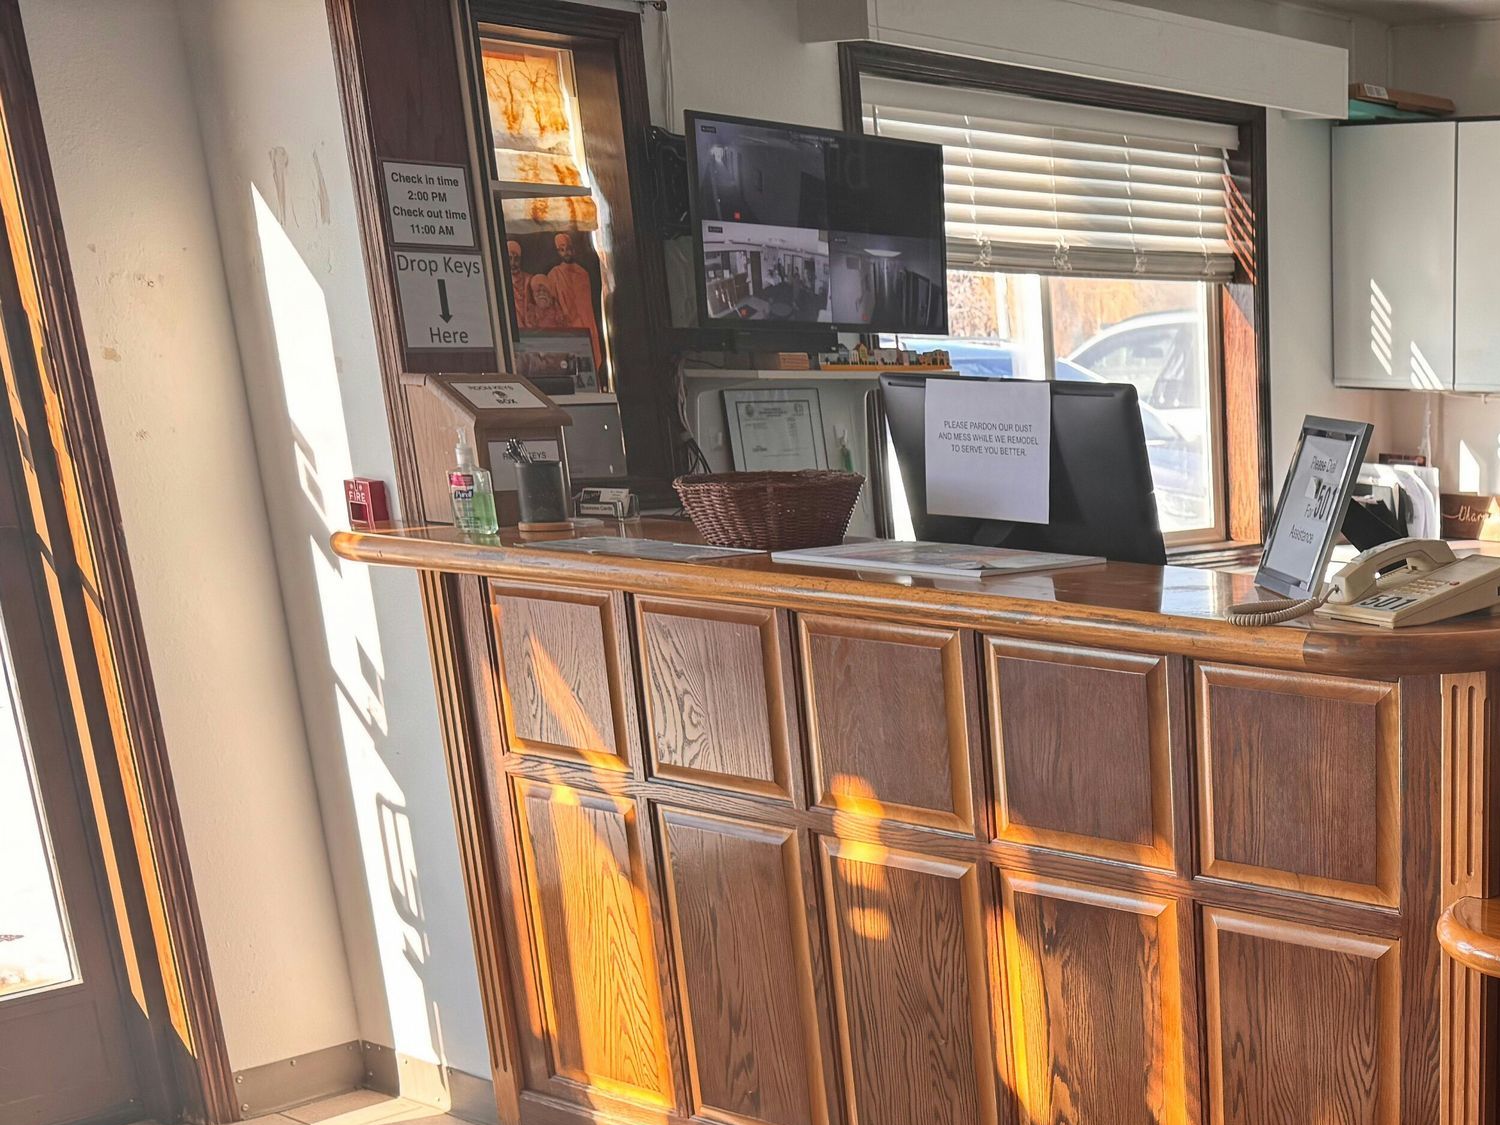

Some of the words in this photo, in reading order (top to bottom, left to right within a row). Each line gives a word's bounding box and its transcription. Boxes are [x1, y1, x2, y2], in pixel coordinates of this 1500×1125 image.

[391, 172, 423, 185] Check
[437, 176, 459, 187] time
[407, 190, 429, 201] 2:00
[431, 192, 447, 202] PM
[392, 206, 424, 218] Check
[426, 209, 443, 219] out
[445, 210, 467, 220] time
[410, 224, 436, 235] 11:00
[438, 226, 455, 235] AM
[397, 255, 438, 276] Drop
[443, 256, 480, 278] Keys
[429, 327, 469, 344] Here
[944, 420, 968, 430] PLEASE
[969, 421, 997, 431] PARDON
[998, 423, 1013, 432] OUR
[1014, 423, 1032, 433] DUST
[938, 432, 952, 441] AND
[953, 432, 972, 442] MESS
[972, 433, 993, 443] WHILE
[994, 435, 1006, 444] WE
[1007, 435, 1039, 446] REMODEL
[951, 444, 960, 453] TO
[961, 444, 983, 454] SERVE
[984, 446, 998, 455] YOU
[1311, 456, 1327, 473] Please
[349, 491, 366, 503] FIRE
[1314, 484, 1338, 520] 501
[1360, 594, 1418, 610] 501
